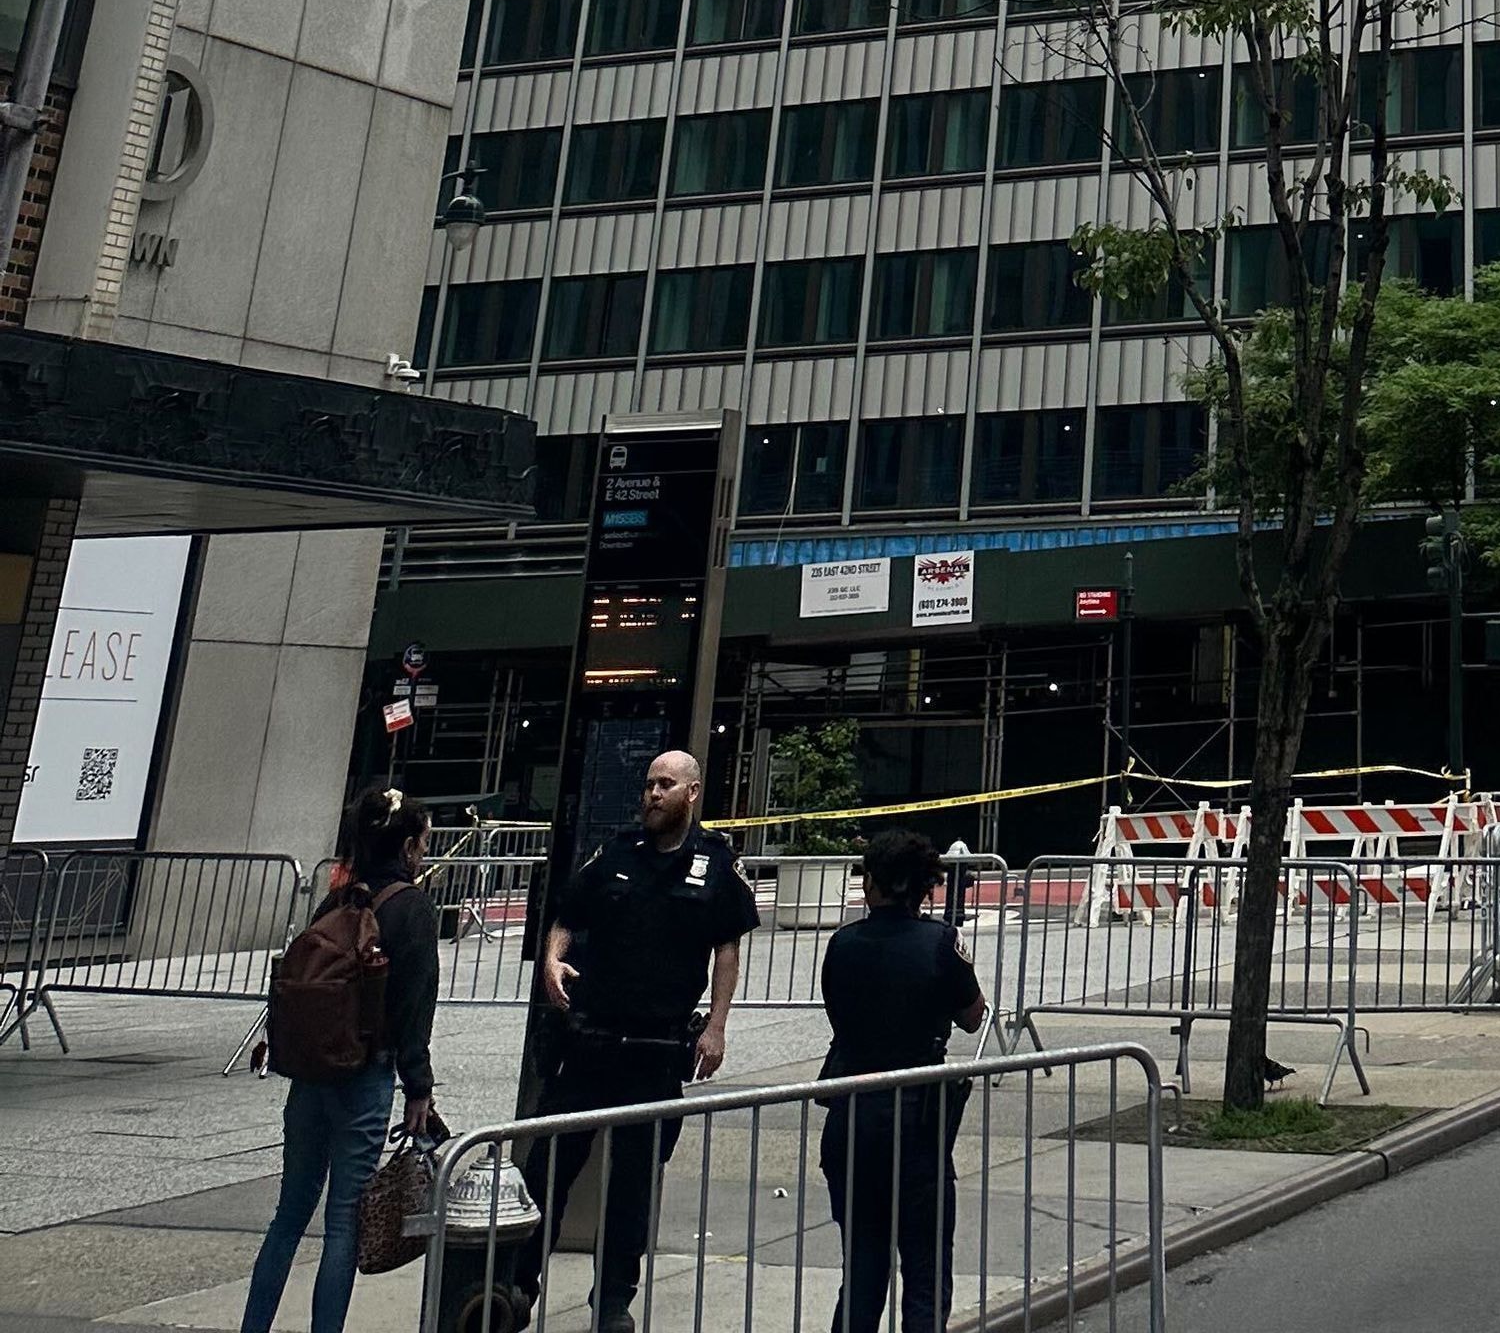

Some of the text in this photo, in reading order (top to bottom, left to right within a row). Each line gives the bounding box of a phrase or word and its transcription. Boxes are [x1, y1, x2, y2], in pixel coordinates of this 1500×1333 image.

[606, 476, 661, 489] 2 Avenue &
[605, 488, 660, 501] E 42 Street
[824, 565, 840, 577] EAST
[840, 564, 858, 575] 42ND
[858, 562, 882, 574] STREET
[921, 564, 967, 574] ARSENAL
[45, 630, 142, 681] EASE
